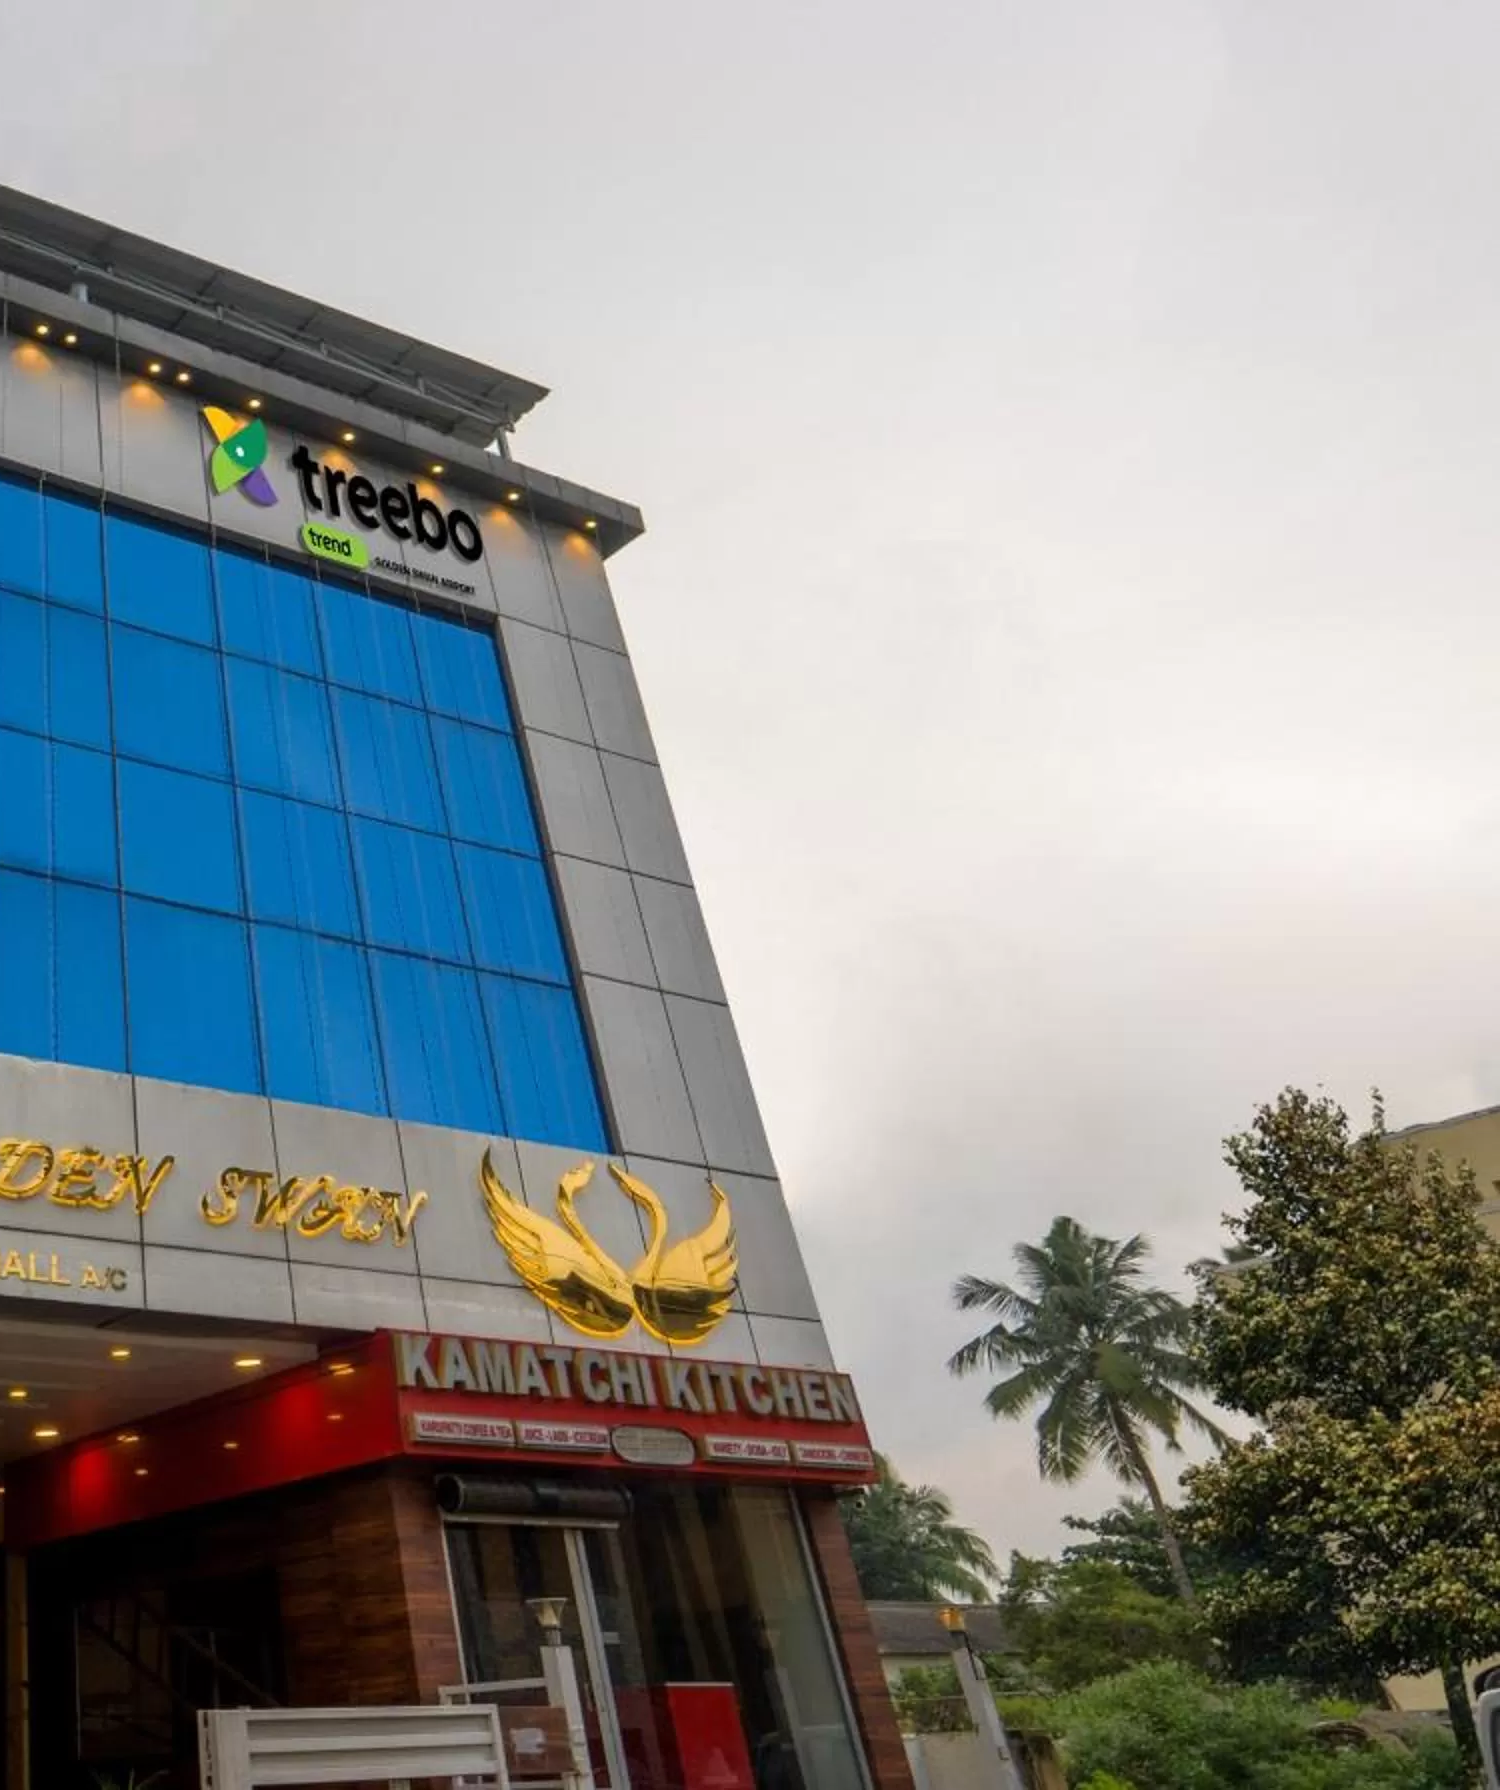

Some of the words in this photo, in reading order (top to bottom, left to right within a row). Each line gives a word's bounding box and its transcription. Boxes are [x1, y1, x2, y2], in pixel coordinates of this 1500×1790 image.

[290, 444, 484, 562] treebo
[308, 527, 353, 558] trend
[200, 1165, 429, 1248] SWAN
[80, 1260, 128, 1293] A/C
[396, 1332, 658, 1407] KAMATCHI
[658, 1359, 863, 1425] KITCHEN
